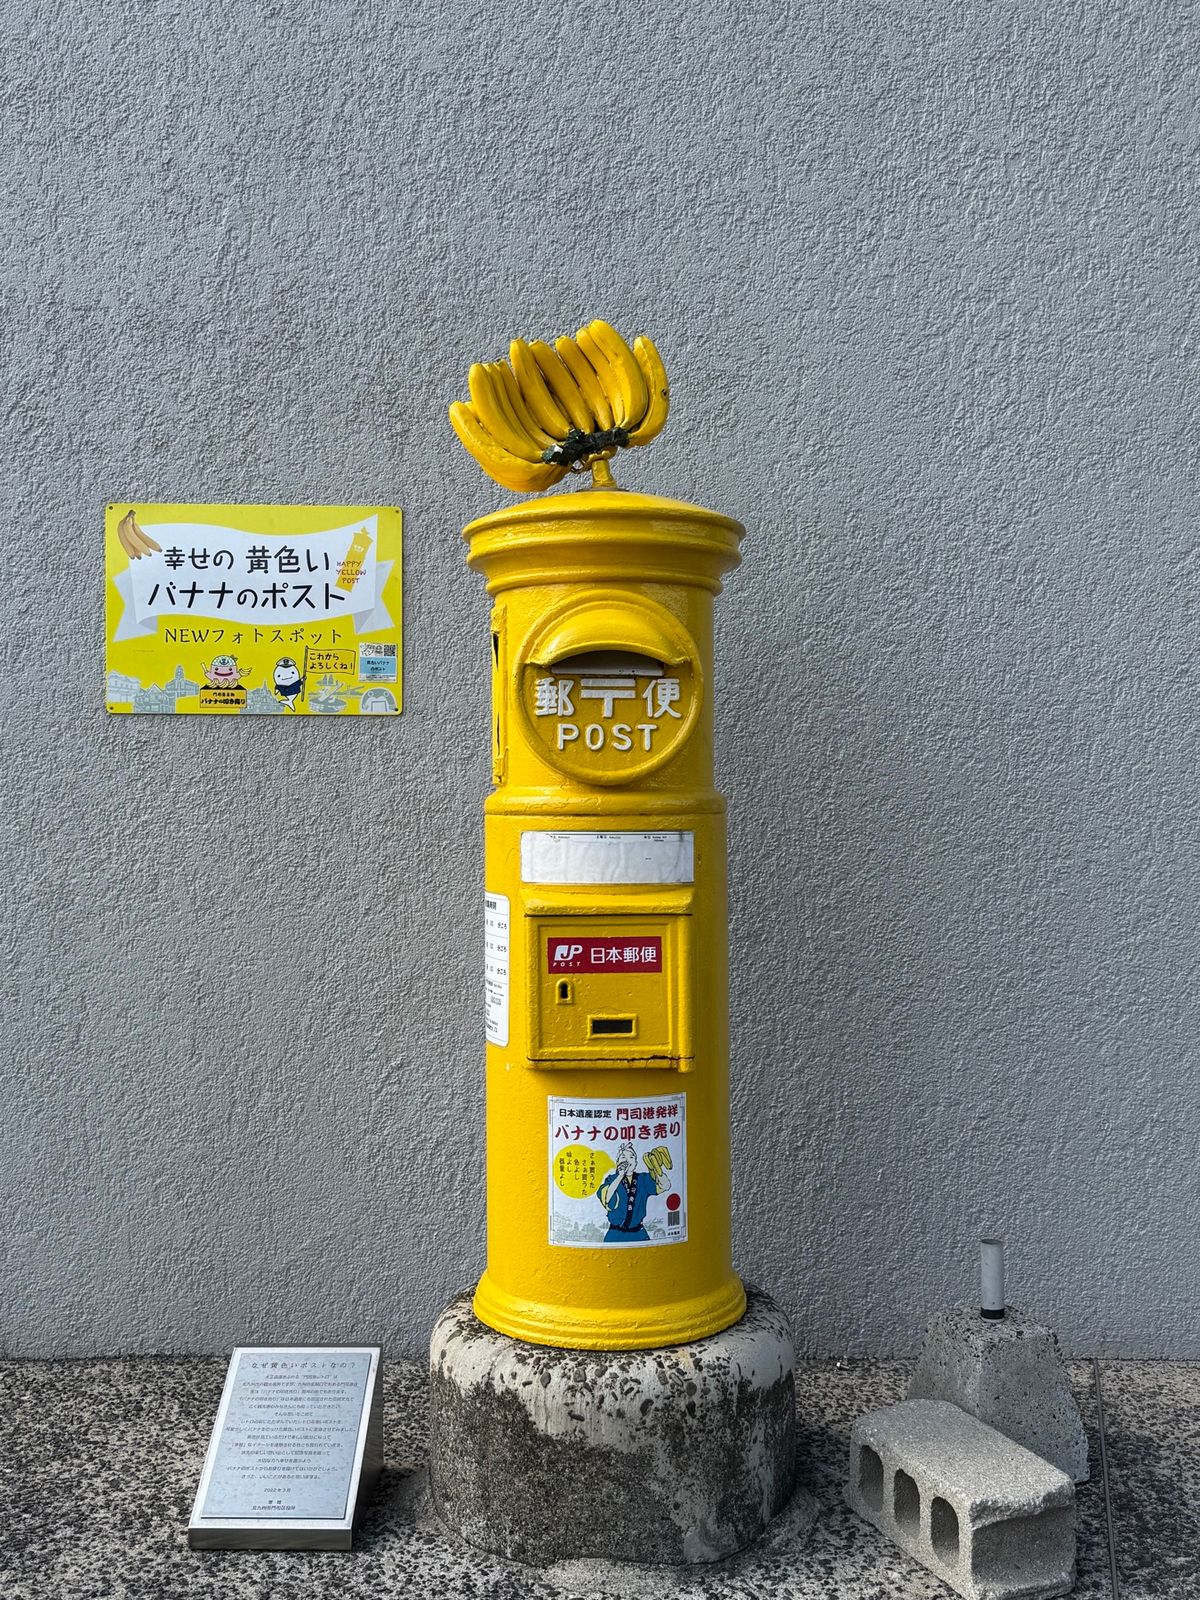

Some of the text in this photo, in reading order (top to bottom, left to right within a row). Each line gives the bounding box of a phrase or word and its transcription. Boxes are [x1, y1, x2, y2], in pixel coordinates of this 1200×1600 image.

[164, 545, 330, 574] 幸せの 黄色い
[148, 581, 346, 609] バナナのポスト
[164, 627, 343, 644] NEWフォトスポット
[557, 723, 658, 751] POST
[591, 946, 657, 964] 日本郵便
[559, 1104, 678, 1121] 日本遺産認定 門司港発祥
[555, 1121, 680, 1141] バナナの叩き売り
